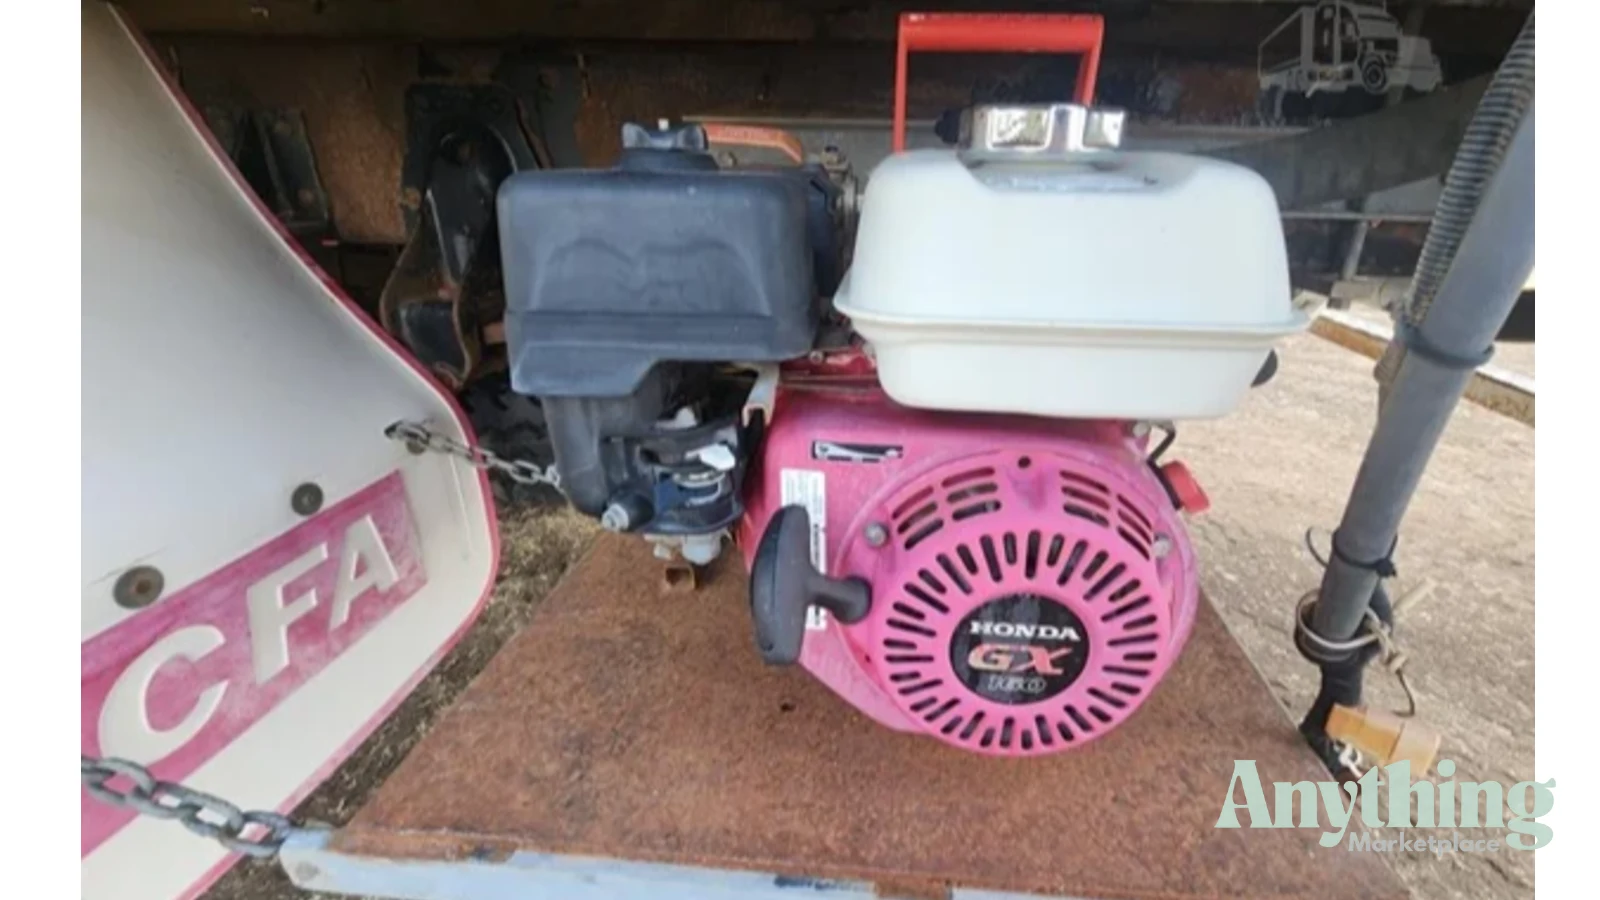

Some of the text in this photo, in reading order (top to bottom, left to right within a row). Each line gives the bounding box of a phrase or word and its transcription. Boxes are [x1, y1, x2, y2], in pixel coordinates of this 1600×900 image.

[97, 514, 400, 768] CFA
[969, 619, 1081, 642] HONDA
[967, 642, 1074, 676] GX
